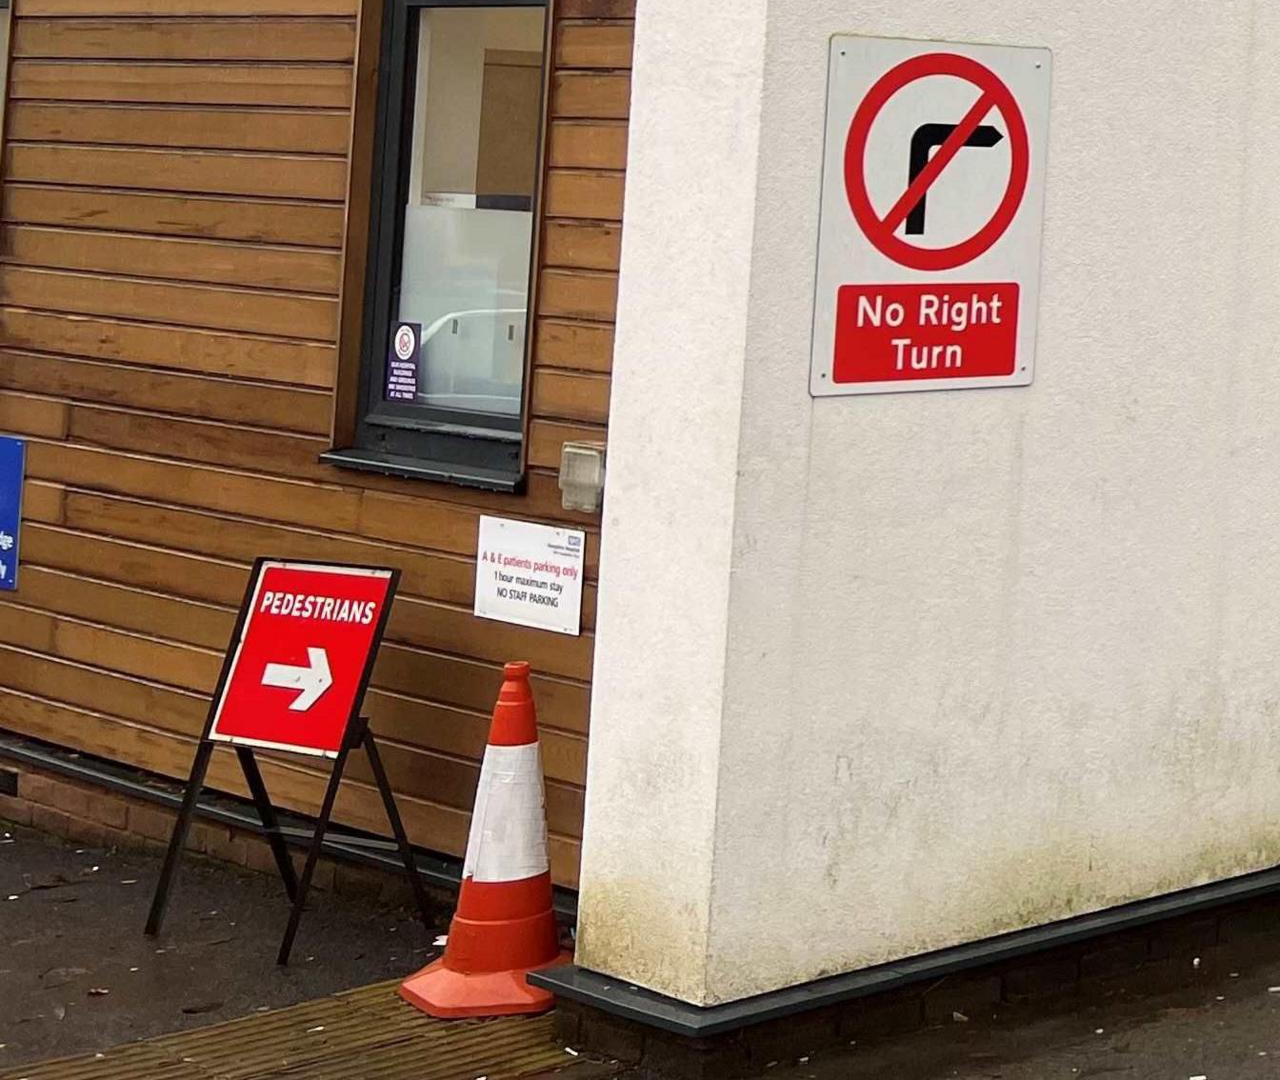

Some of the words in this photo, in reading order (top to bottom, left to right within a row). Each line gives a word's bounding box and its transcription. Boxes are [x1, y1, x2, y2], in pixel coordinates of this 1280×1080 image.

[856, 294, 905, 328] No
[918, 292, 1003, 332] Right
[890, 338, 963, 371] Turn
[482, 551, 488, 561] A
[490, 552, 496, 563] &
[503, 555, 532, 572] patients
[533, 560, 561, 578] parking
[562, 566, 579, 580] only
[497, 587, 508, 598] NO
[508, 589, 528, 602] STAFF
[529, 592, 559, 608] PARKING
[499, 571, 514, 584] hour
[515, 576, 548, 590] maximum
[549, 581, 564, 595] stay
[260, 590, 377, 625] PEDESTRIANS
